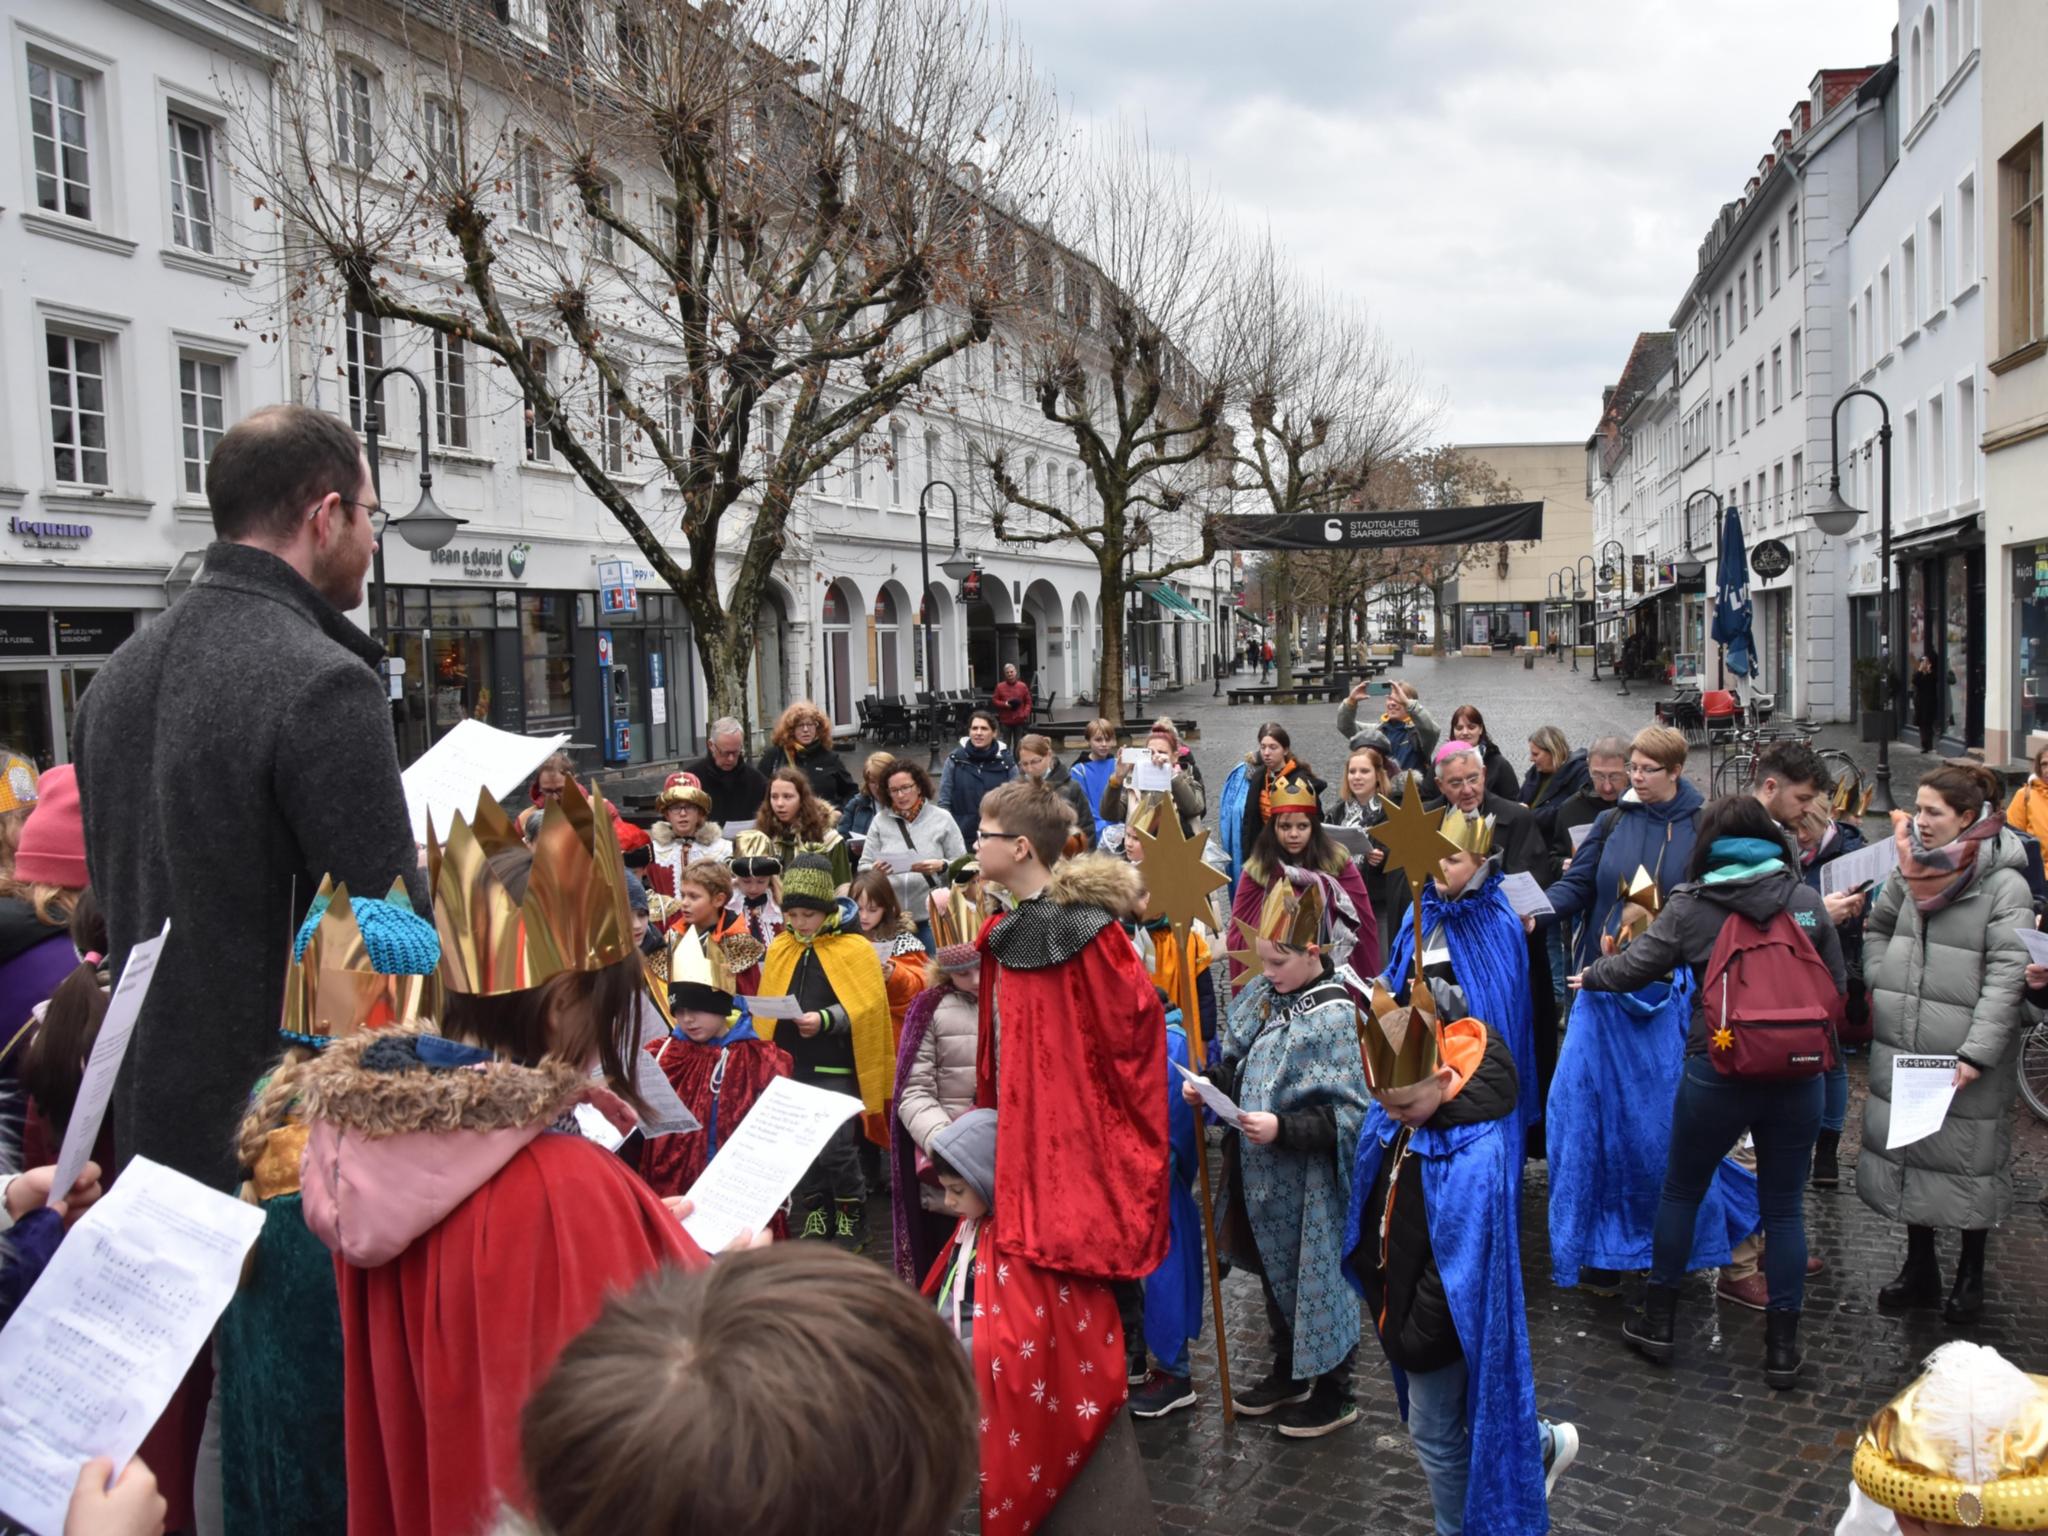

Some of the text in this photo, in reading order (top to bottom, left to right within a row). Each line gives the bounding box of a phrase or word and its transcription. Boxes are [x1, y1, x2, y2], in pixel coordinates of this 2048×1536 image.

[8, 516, 93, 538] leguano
[1349, 520, 1420, 530] STADTGALERIE
[1349, 527, 1420, 538] SAARBRÜCKEN
[462, 550, 470, 565] &
[471, 547, 502, 566] david
[464, 567, 482, 576] fresh
[492, 569, 504, 577] eat
